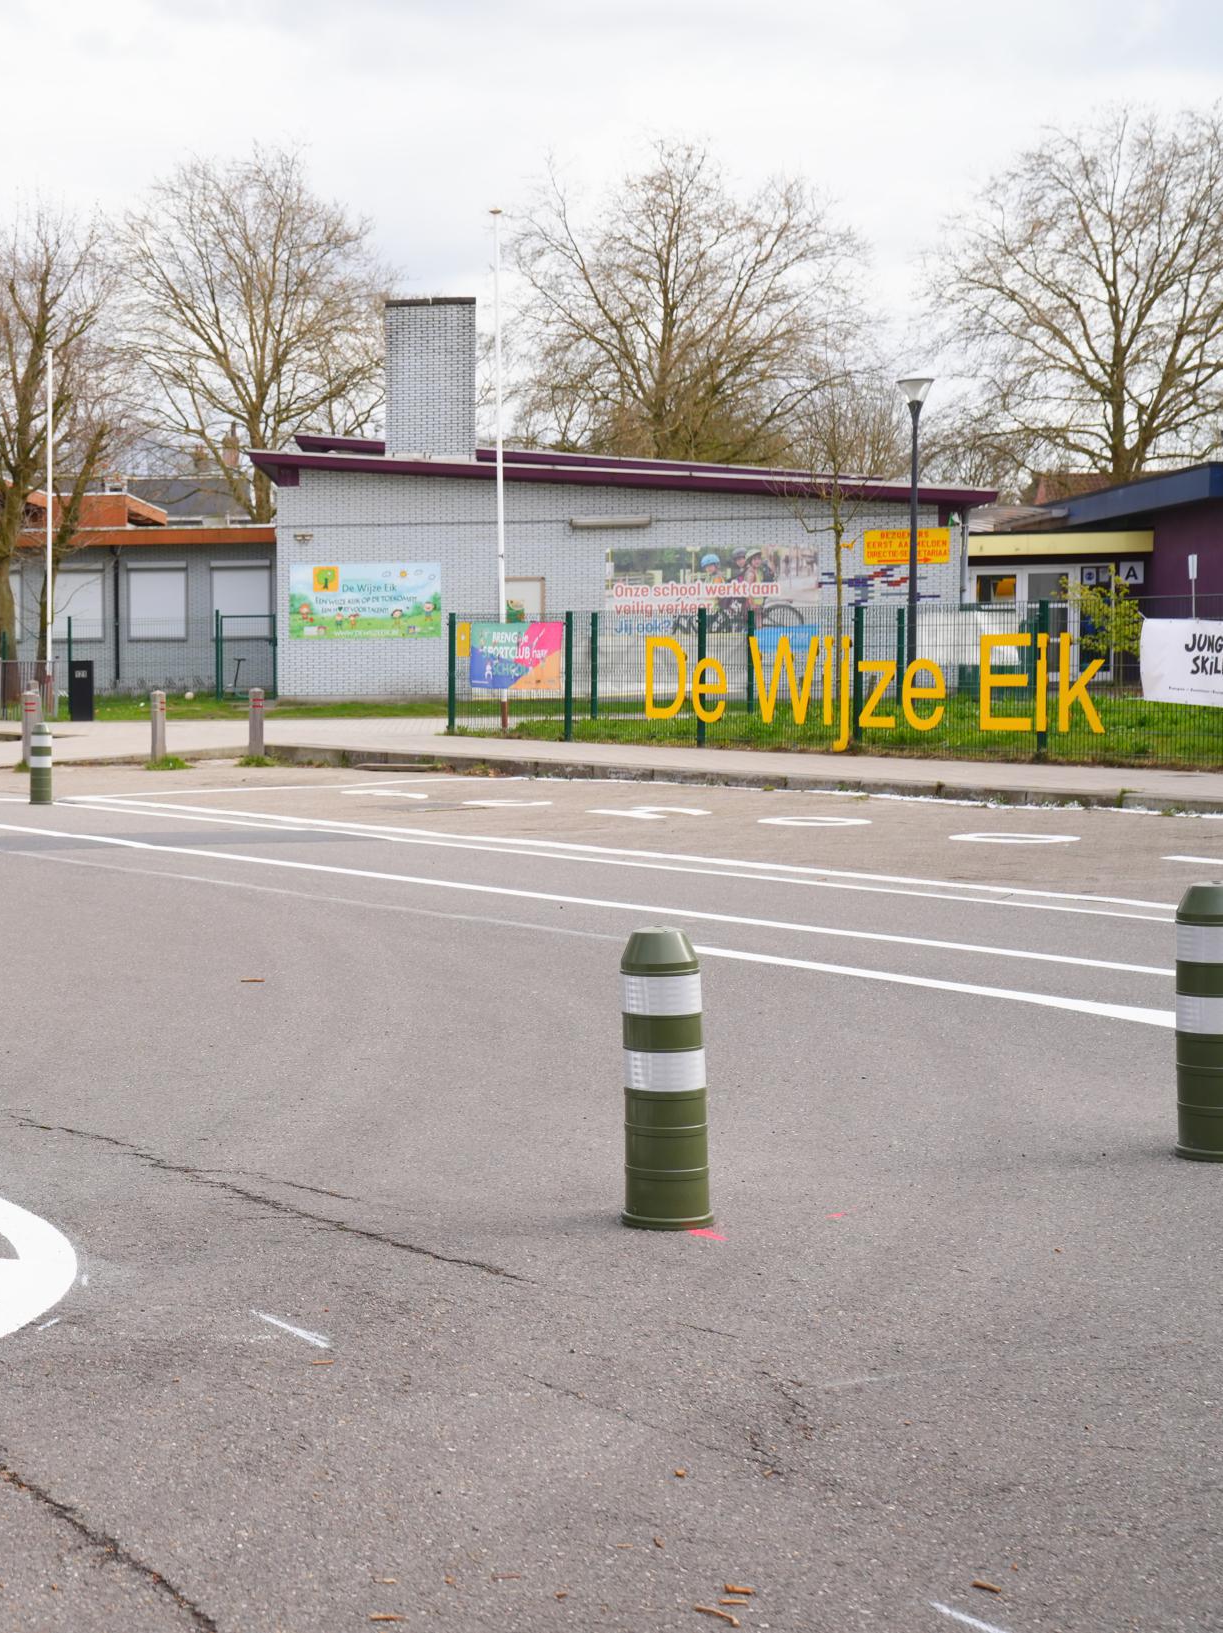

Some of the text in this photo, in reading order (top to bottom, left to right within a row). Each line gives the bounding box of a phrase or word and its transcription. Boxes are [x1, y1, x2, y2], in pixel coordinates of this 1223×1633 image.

[881, 531, 929, 539] BEZOEKRS
[899, 540, 947, 548] AAMELDEN
[1125, 566, 1139, 580] A
[342, 583, 397, 595] De Wijze Eik
[614, 582, 778, 598] Onze school werkt aan
[614, 601, 653, 617] veilig
[615, 618, 671, 637] Jij ook?
[645, 632, 1105, 752] De Wijze Eik
